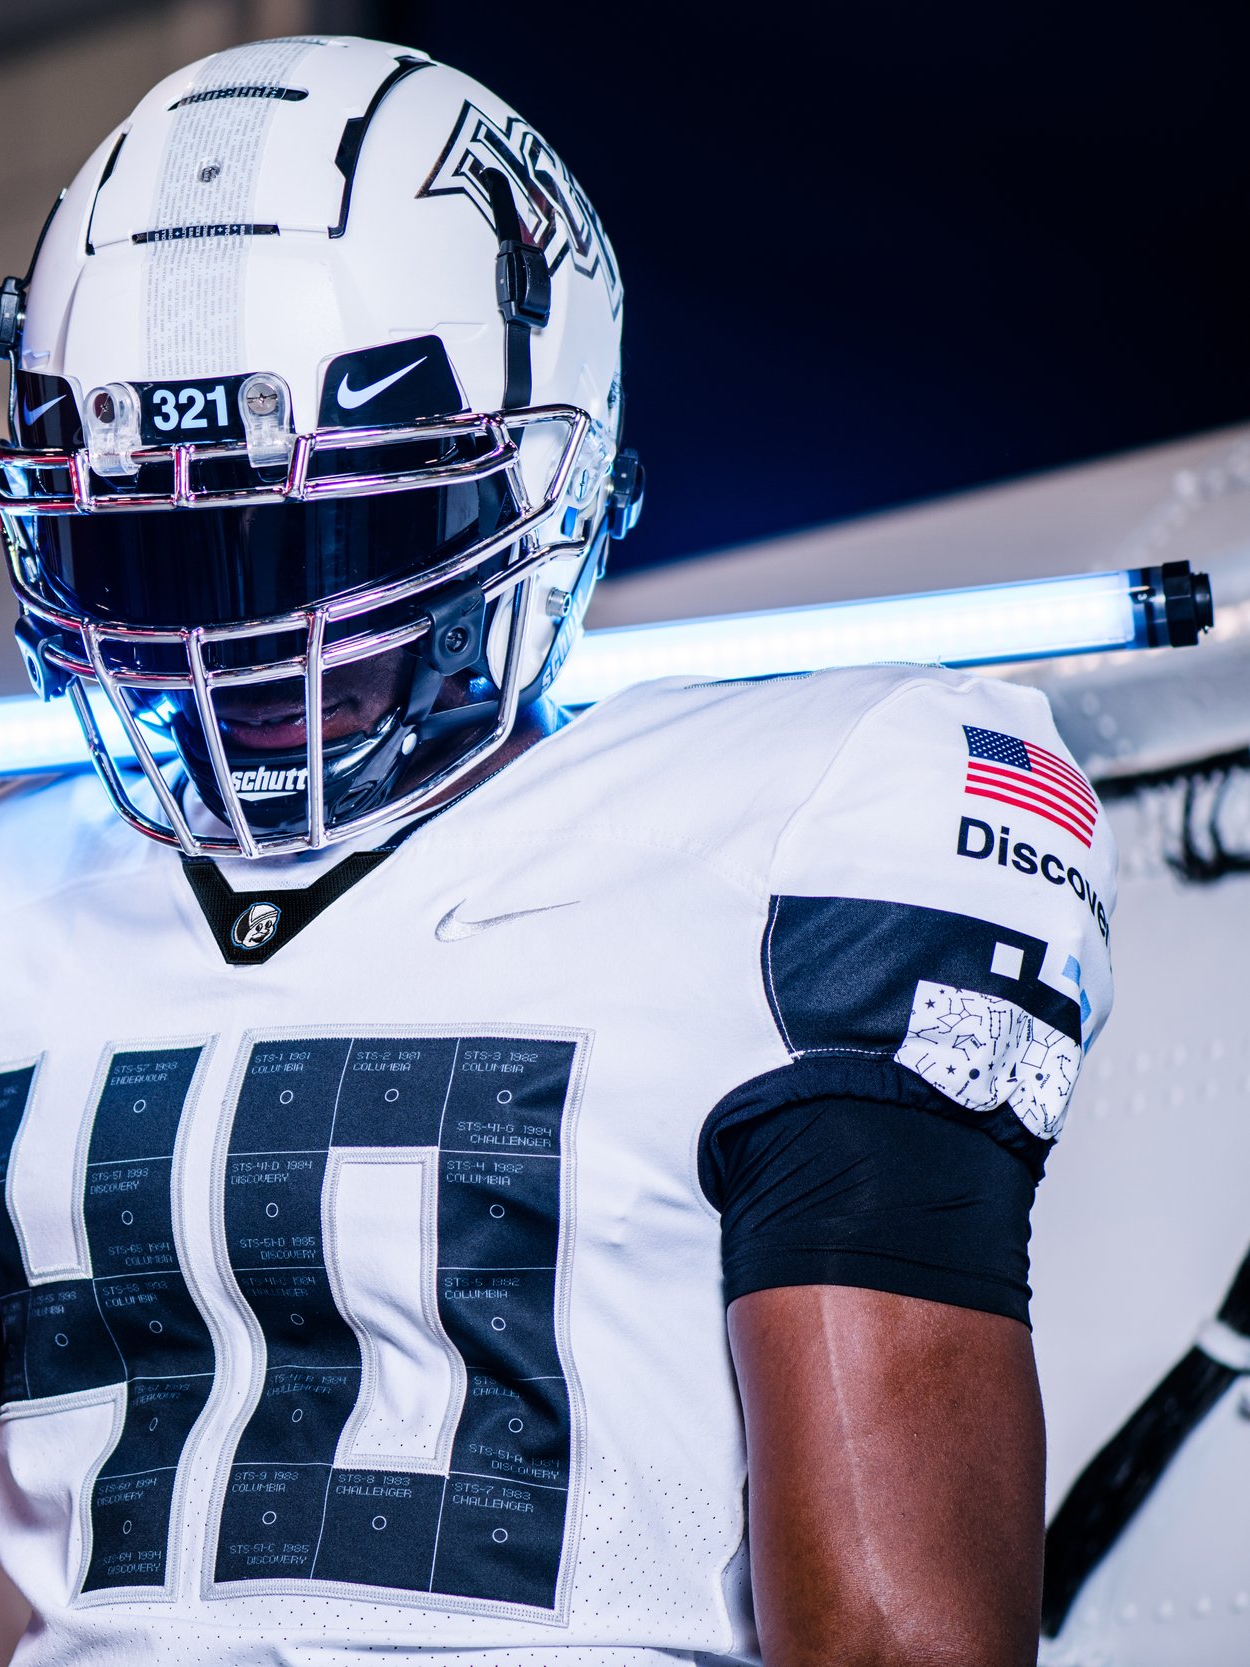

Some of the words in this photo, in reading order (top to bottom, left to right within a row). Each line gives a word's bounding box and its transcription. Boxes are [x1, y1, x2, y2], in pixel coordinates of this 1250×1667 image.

[152, 385, 229, 431] 321
[355, 1051, 391, 1061] STS-2
[398, 1051, 421, 1061] 1981
[464, 1050, 502, 1061] STS-3
[510, 1052, 539, 1063] 1982
[251, 1062, 304, 1075] COLUMBIA
[352, 1062, 411, 1072] COLUMBIA
[461, 1062, 525, 1073] COLUMBIA
[523, 1124, 552, 1137] 1984
[469, 1134, 552, 1147] CHALLENGER
[287, 1160, 313, 1171] 1984
[446, 1160, 485, 1171] STS-4
[230, 1173, 289, 1185] DISCOVERY
[446, 1173, 511, 1186] COLUMBIA
[90, 1180, 139, 1195] DISCOVERY
[260, 1250, 317, 1261] DISCOVERY
[444, 1289, 508, 1300] COLUMBIA
[491, 1460, 560, 1481] DISCOVERY
[338, 1473, 375, 1484] STS-8
[382, 1475, 410, 1486] 1983
[232, 1483, 286, 1493] COLUMBIA
[335, 1485, 412, 1498] CHALLENGER
[502, 1487, 531, 1501] 1983
[452, 1494, 534, 1513] CHALLENGER
[246, 1555, 307, 1565] DISCOVERY
